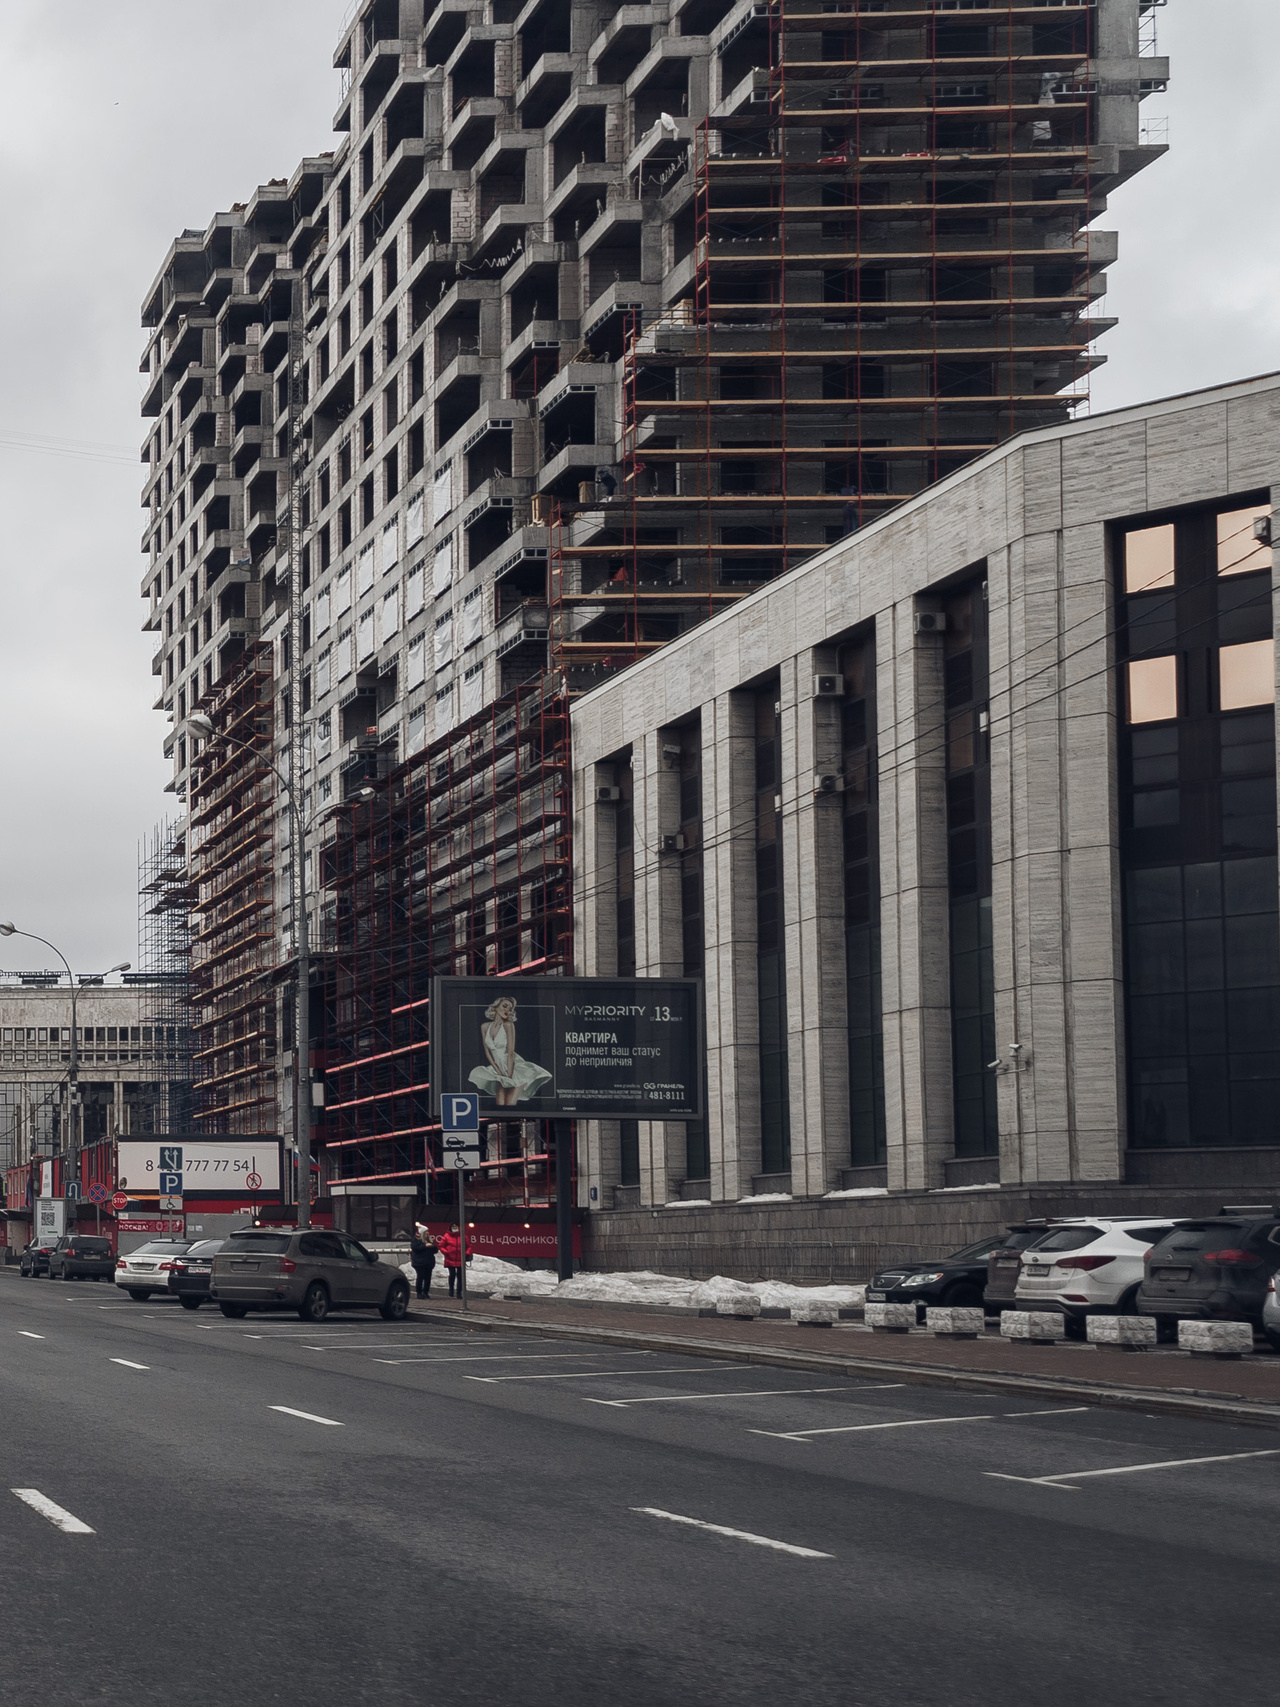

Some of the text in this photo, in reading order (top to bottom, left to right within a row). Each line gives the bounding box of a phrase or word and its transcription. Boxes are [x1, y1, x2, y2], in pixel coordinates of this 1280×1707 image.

[655, 1006, 671, 1021] 13
[565, 1032, 618, 1043] КВАРТИРА
[565, 1046, 661, 1058] поднимет ваш статус
[565, 1057, 632, 1067] до неприличия
[649, 1091, 685, 1100] 481-8111
[451, 1098, 472, 1126] P
[145, 1160, 154, 1171] 8
[186, 1160, 209, 1171] 777
[213, 1160, 230, 1171] 77
[233, 1160, 249, 1171] 54
[166, 1175, 179, 1193] P
[470, 1235, 477, 1243] В
[480, 1235, 494, 1245] БЦ
